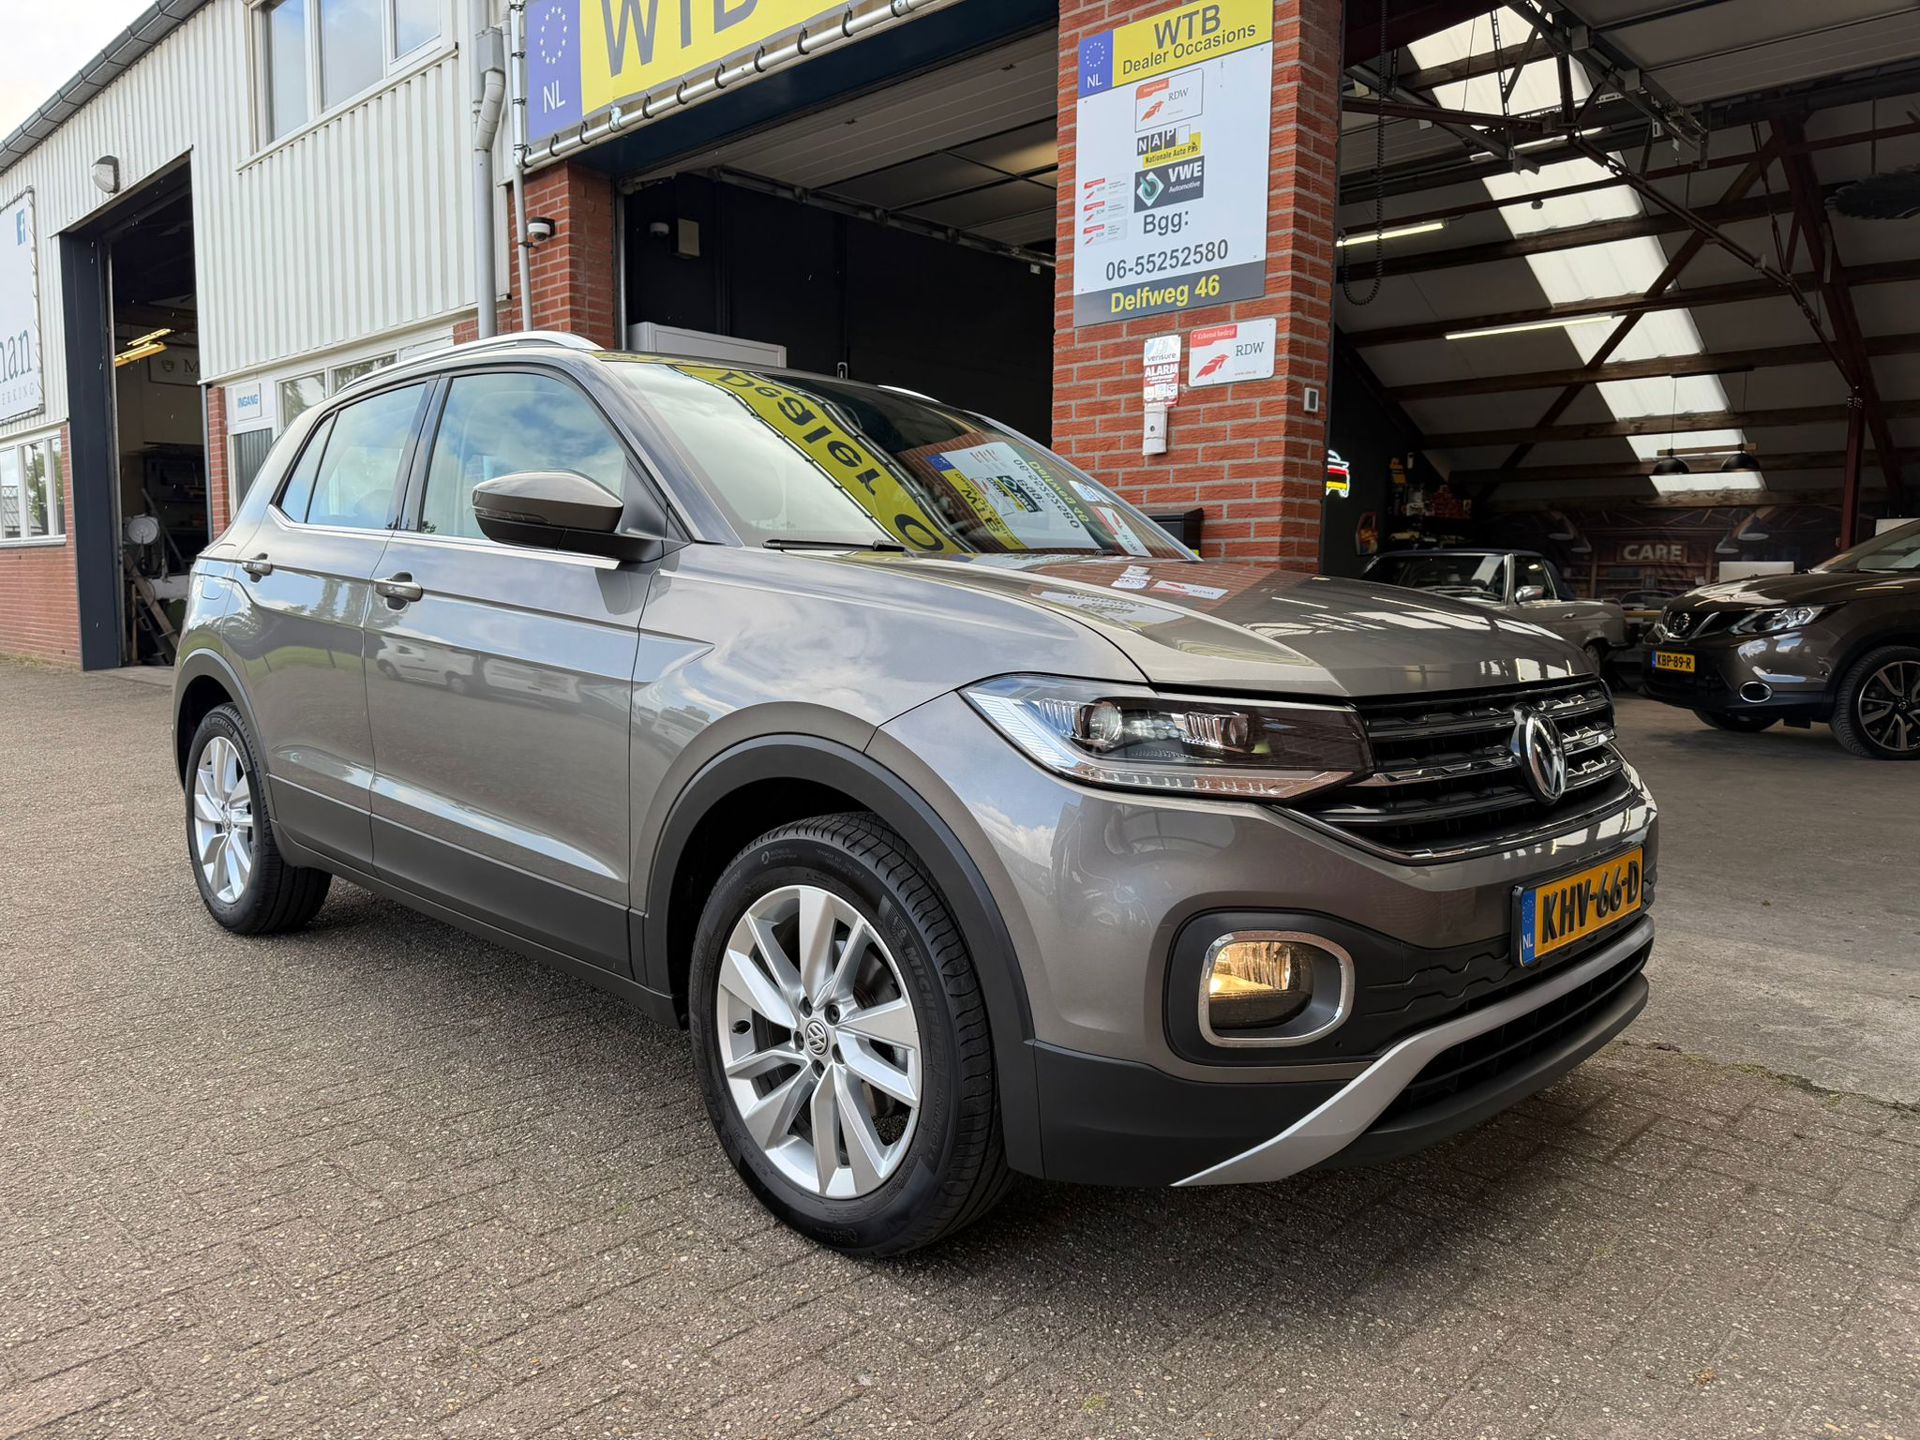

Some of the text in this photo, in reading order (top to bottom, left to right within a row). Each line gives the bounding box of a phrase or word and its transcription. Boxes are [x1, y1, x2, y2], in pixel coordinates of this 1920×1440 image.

[1154, 4, 1221, 49] WTB
[1123, 24, 1256, 75] Dealer Occasions
[1087, 73, 1102, 88] NL
[543, 80, 566, 114] NL
[1168, 88, 1189, 101] RDW
[1168, 161, 1202, 182] VWE
[1169, 181, 1200, 193] Automotive
[1143, 210, 1189, 236] Bgg:
[1106, 239, 1228, 281] 06-55252580
[1111, 274, 1221, 313] Delfweg 46
[1235, 341, 1264, 356] RDW
[1145, 363, 1178, 377] ALARM
[1623, 544, 1682, 560] CARE
[1541, 860, 1640, 944] KHV-66-D
[1522, 932, 1533, 950] NL
